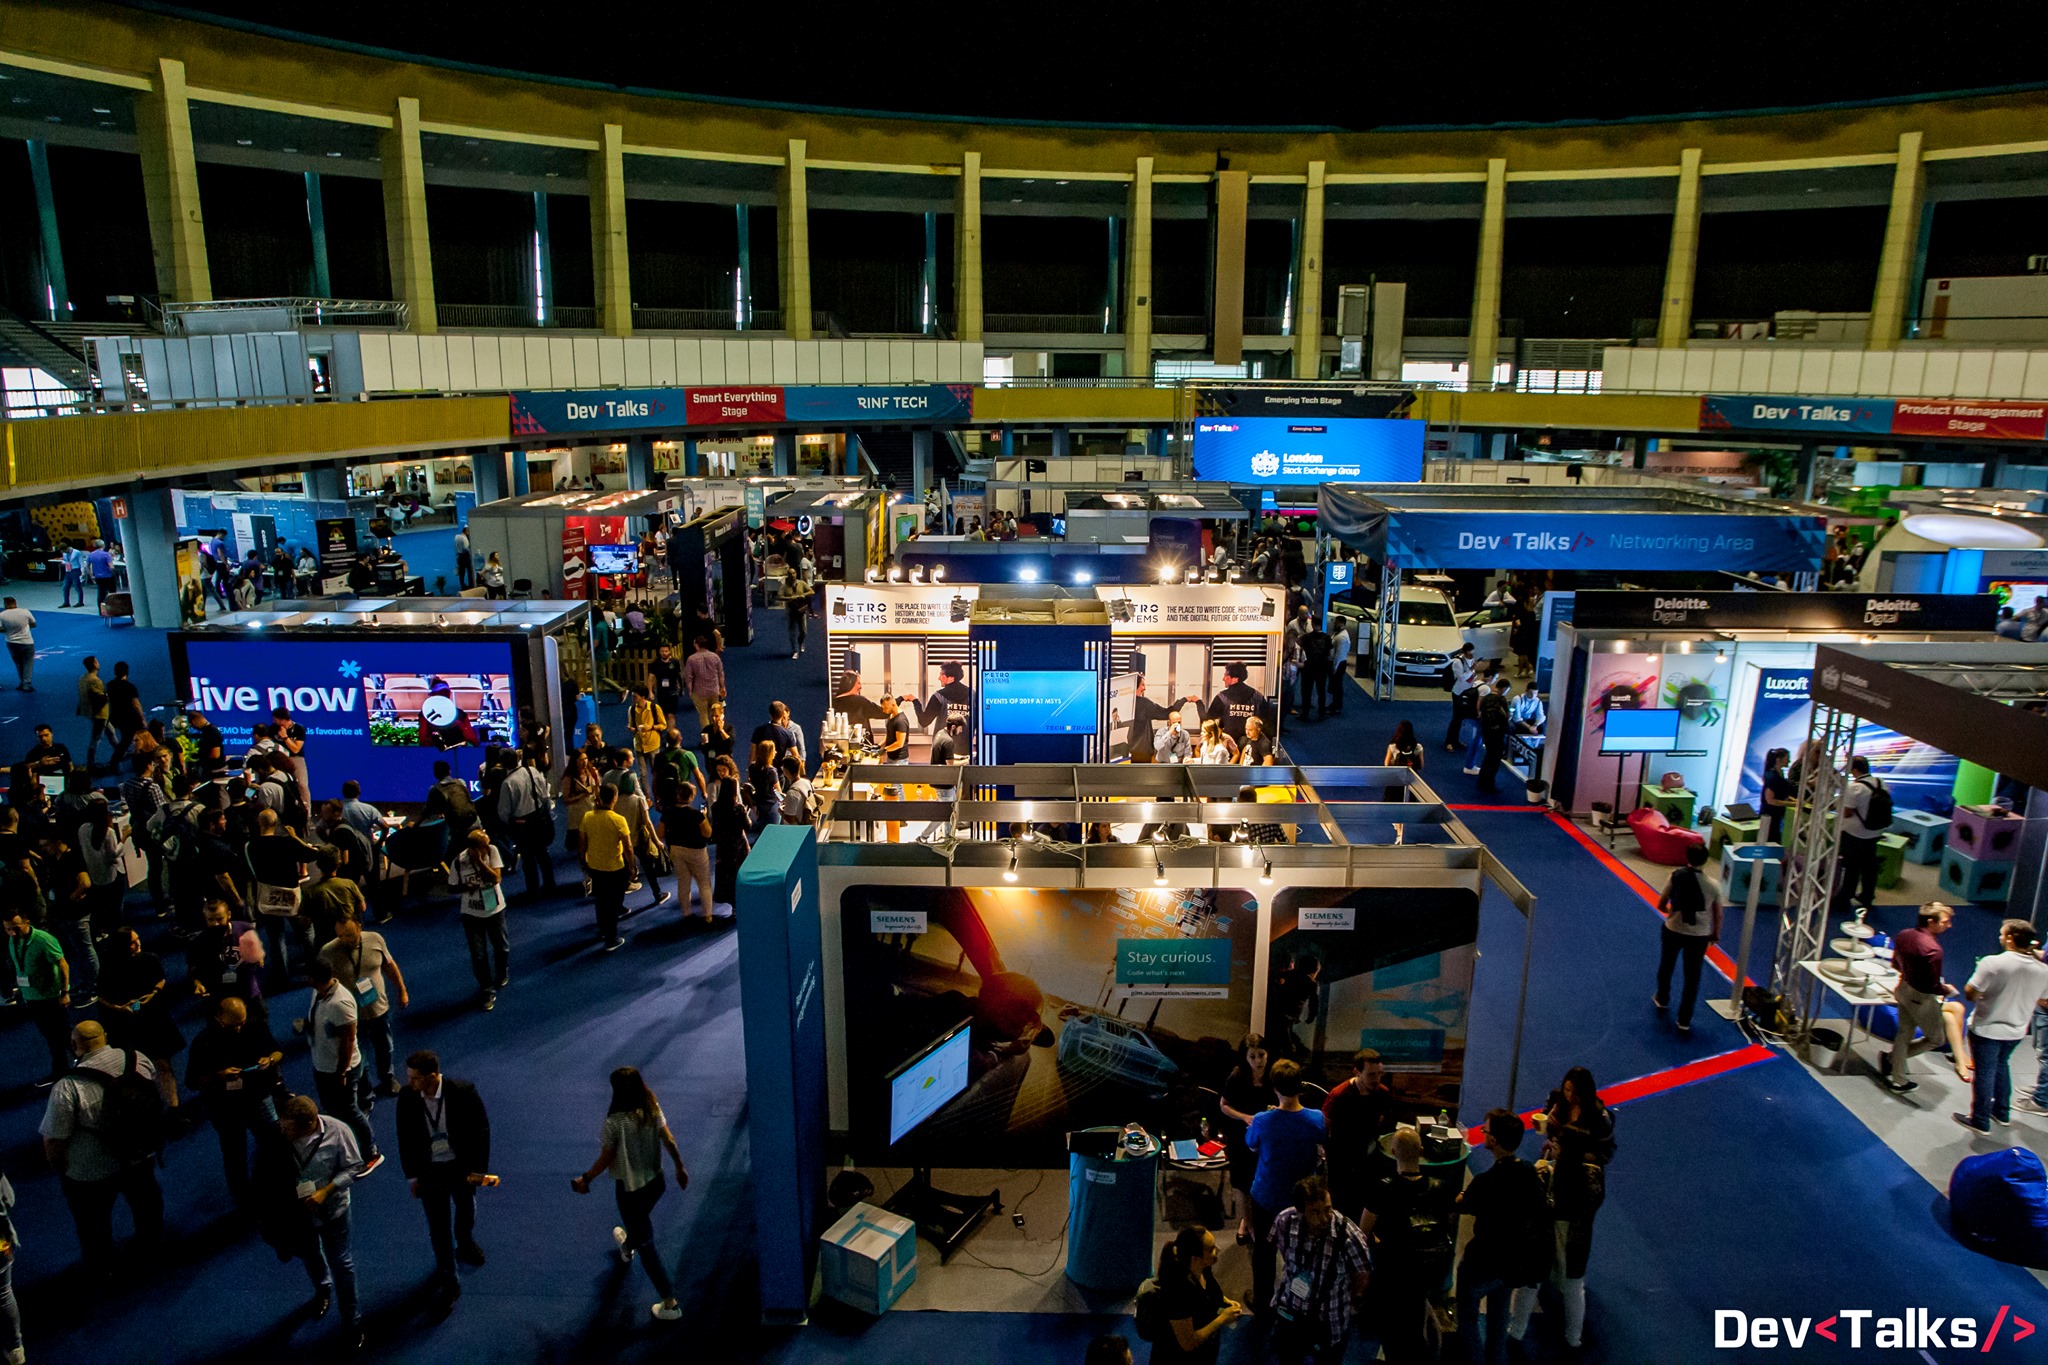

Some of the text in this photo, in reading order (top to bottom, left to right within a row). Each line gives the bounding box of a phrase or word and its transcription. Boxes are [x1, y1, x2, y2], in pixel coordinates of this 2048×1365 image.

[693, 392, 777, 406] Smart Everything
[894, 397, 928, 408] TECH
[1264, 396, 1342, 406] Emerging Tech Stage
[721, 405, 748, 418] Stage
[1898, 404, 2045, 419] Product Management
[1947, 419, 1986, 432] Stage
[1283, 453, 1323, 463] London
[1282, 467, 1361, 476] Stock Exchange Group
[115, 503, 125, 516] H
[1609, 533, 1709, 552] Networking
[1713, 535, 1755, 550] Area
[847, 603, 887, 612] ETRO
[834, 615, 888, 624] SYSTEMS
[1652, 610, 1688, 625] Digital
[1863, 612, 1900, 626] Digital
[190, 677, 358, 712] live now
[315, 727, 351, 735] favourite
[229, 737, 253, 745] stand
[1128, 951, 1216, 966] Stay curious.
[1131, 988, 1221, 997] plm.automation.siemens.com
